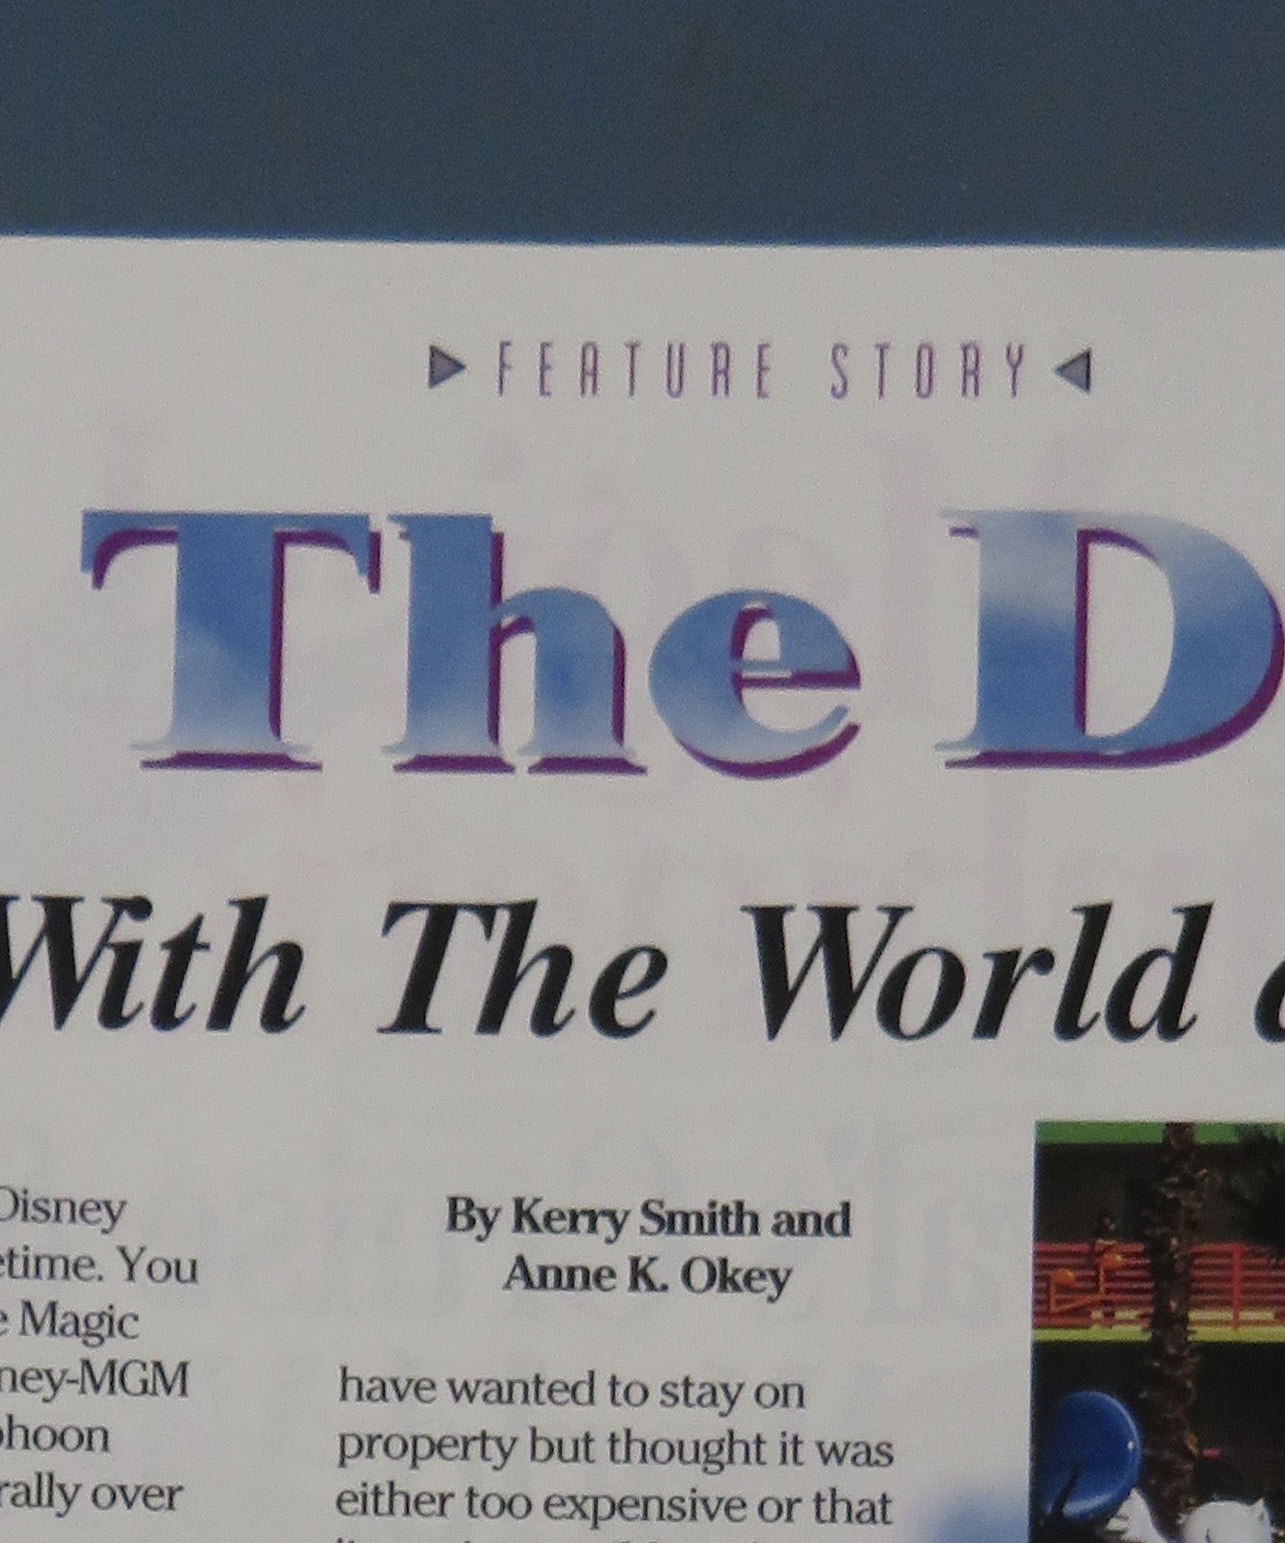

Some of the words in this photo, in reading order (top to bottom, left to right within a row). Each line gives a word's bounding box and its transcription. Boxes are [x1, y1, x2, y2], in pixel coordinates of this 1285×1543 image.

[497, 339, 772, 400] FEATURE
[829, 339, 1025, 401] STORY
[81, 508, 863, 780] The
[377, 899, 667, 1039] The
[740, 902, 1213, 1042] World
[446, 1195, 502, 1243] By
[512, 1196, 631, 1245] Kerry
[640, 1199, 761, 1236] Smith
[771, 1200, 852, 1238] and
[502, 1254, 617, 1292] Anne
[628, 1256, 669, 1293] K.
[681, 1256, 793, 1304] Okey
[19, 1299, 139, 1348] Magic
[338, 1429, 519, 1471] property
[529, 1426, 596, 1464] but
[608, 1427, 767, 1475] thought
[779, 1431, 804, 1466] it
[815, 1440, 894, 1468] was
